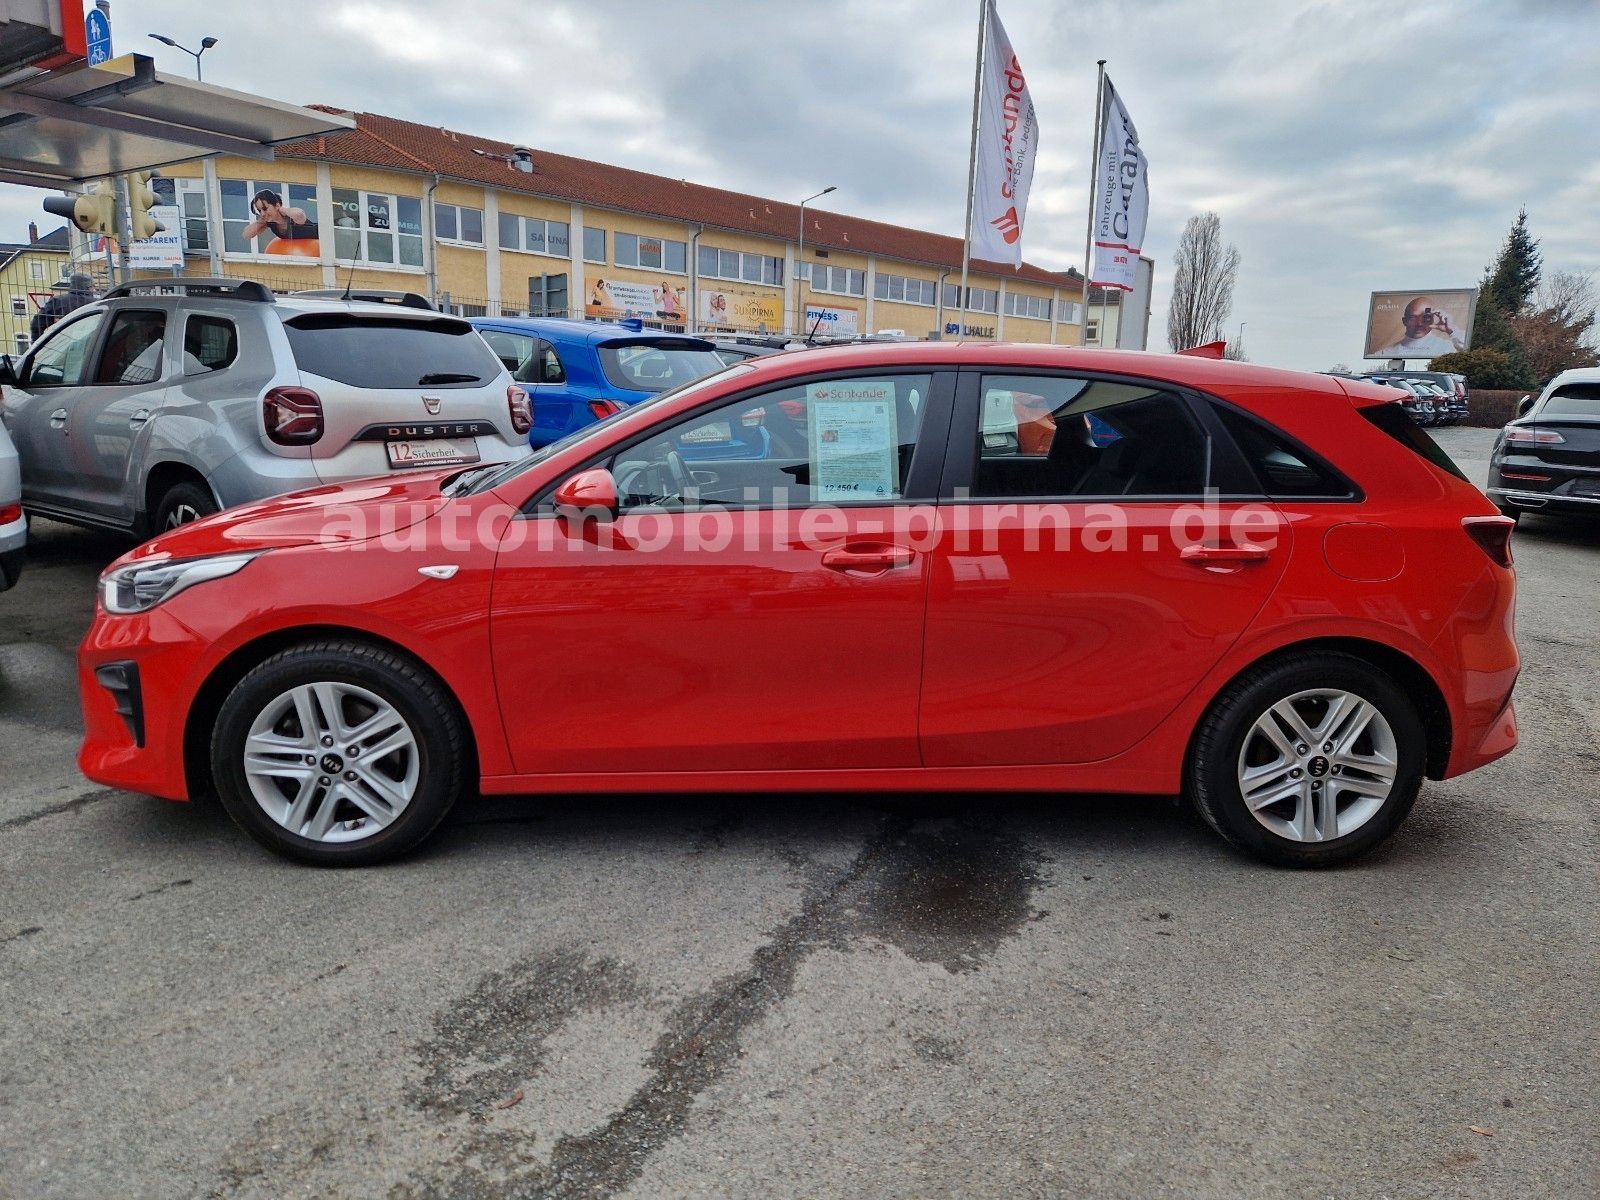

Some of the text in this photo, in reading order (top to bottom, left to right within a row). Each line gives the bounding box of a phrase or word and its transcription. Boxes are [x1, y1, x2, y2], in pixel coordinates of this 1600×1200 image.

[1100, 150, 1117, 238] Fahrzeuge mit
[340, 202, 388, 215] YOGA
[530, 232, 568, 245] SAUNA
[945, 322, 995, 338] SPILHALLE
[830, 388, 887, 399] Santander
[388, 424, 478, 436] DUSTER
[391, 443, 412, 461] 12
[412, 447, 456, 459] Sicherheit
[1313, 758, 1325, 776] KIA
